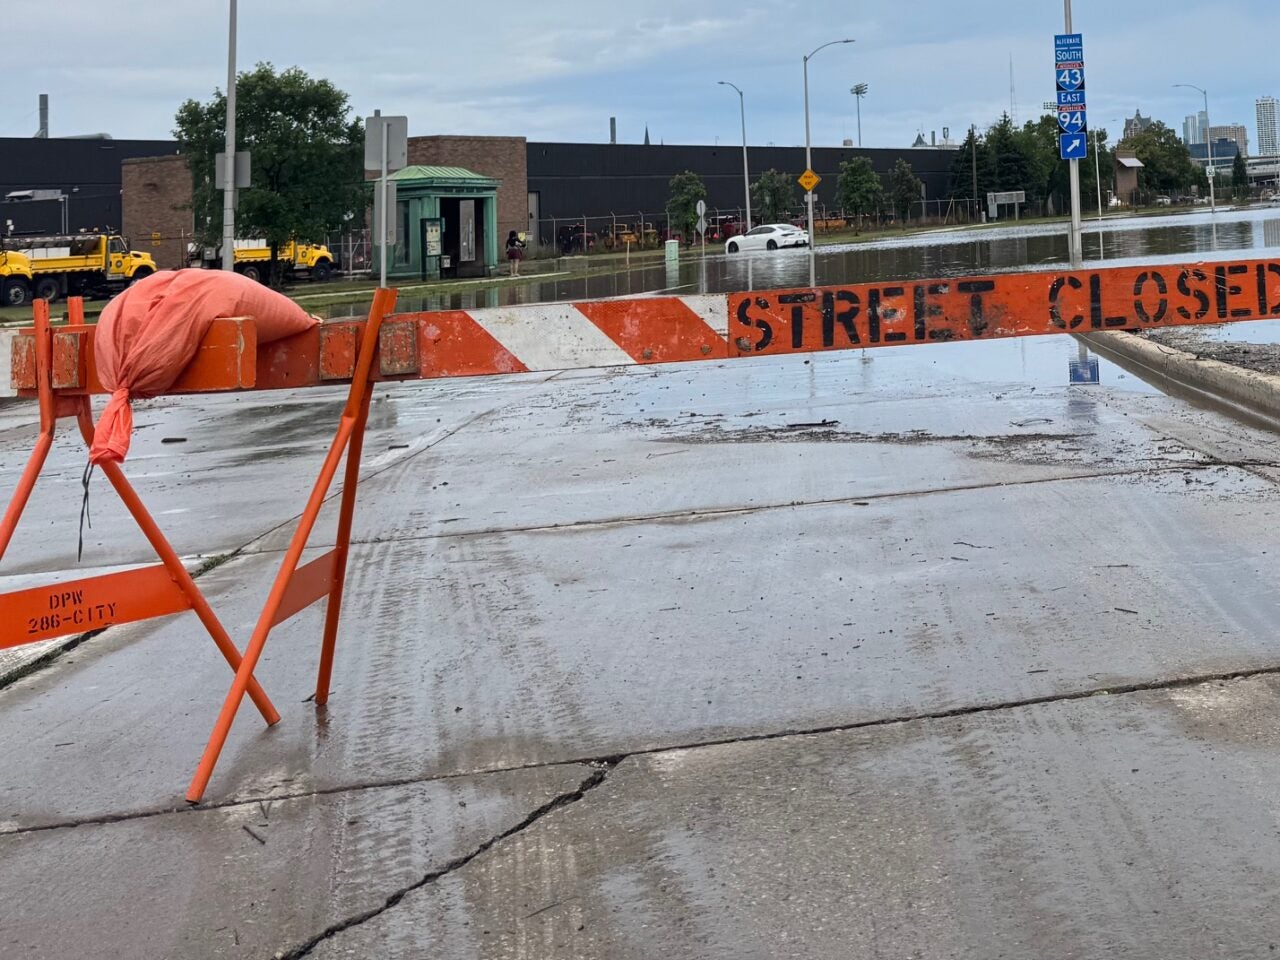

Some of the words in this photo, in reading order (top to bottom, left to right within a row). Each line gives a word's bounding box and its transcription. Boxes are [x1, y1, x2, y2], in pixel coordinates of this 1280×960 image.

[1056, 50, 1082, 60] SOUTH
[1059, 69, 1082, 85] 43
[1061, 93, 1080, 103] EAST
[1060, 112, 1083, 128] 94
[735, 280, 995, 352] STREET
[49, 590, 83, 610] DPW
[28, 602, 116, 634] 286-CITY
